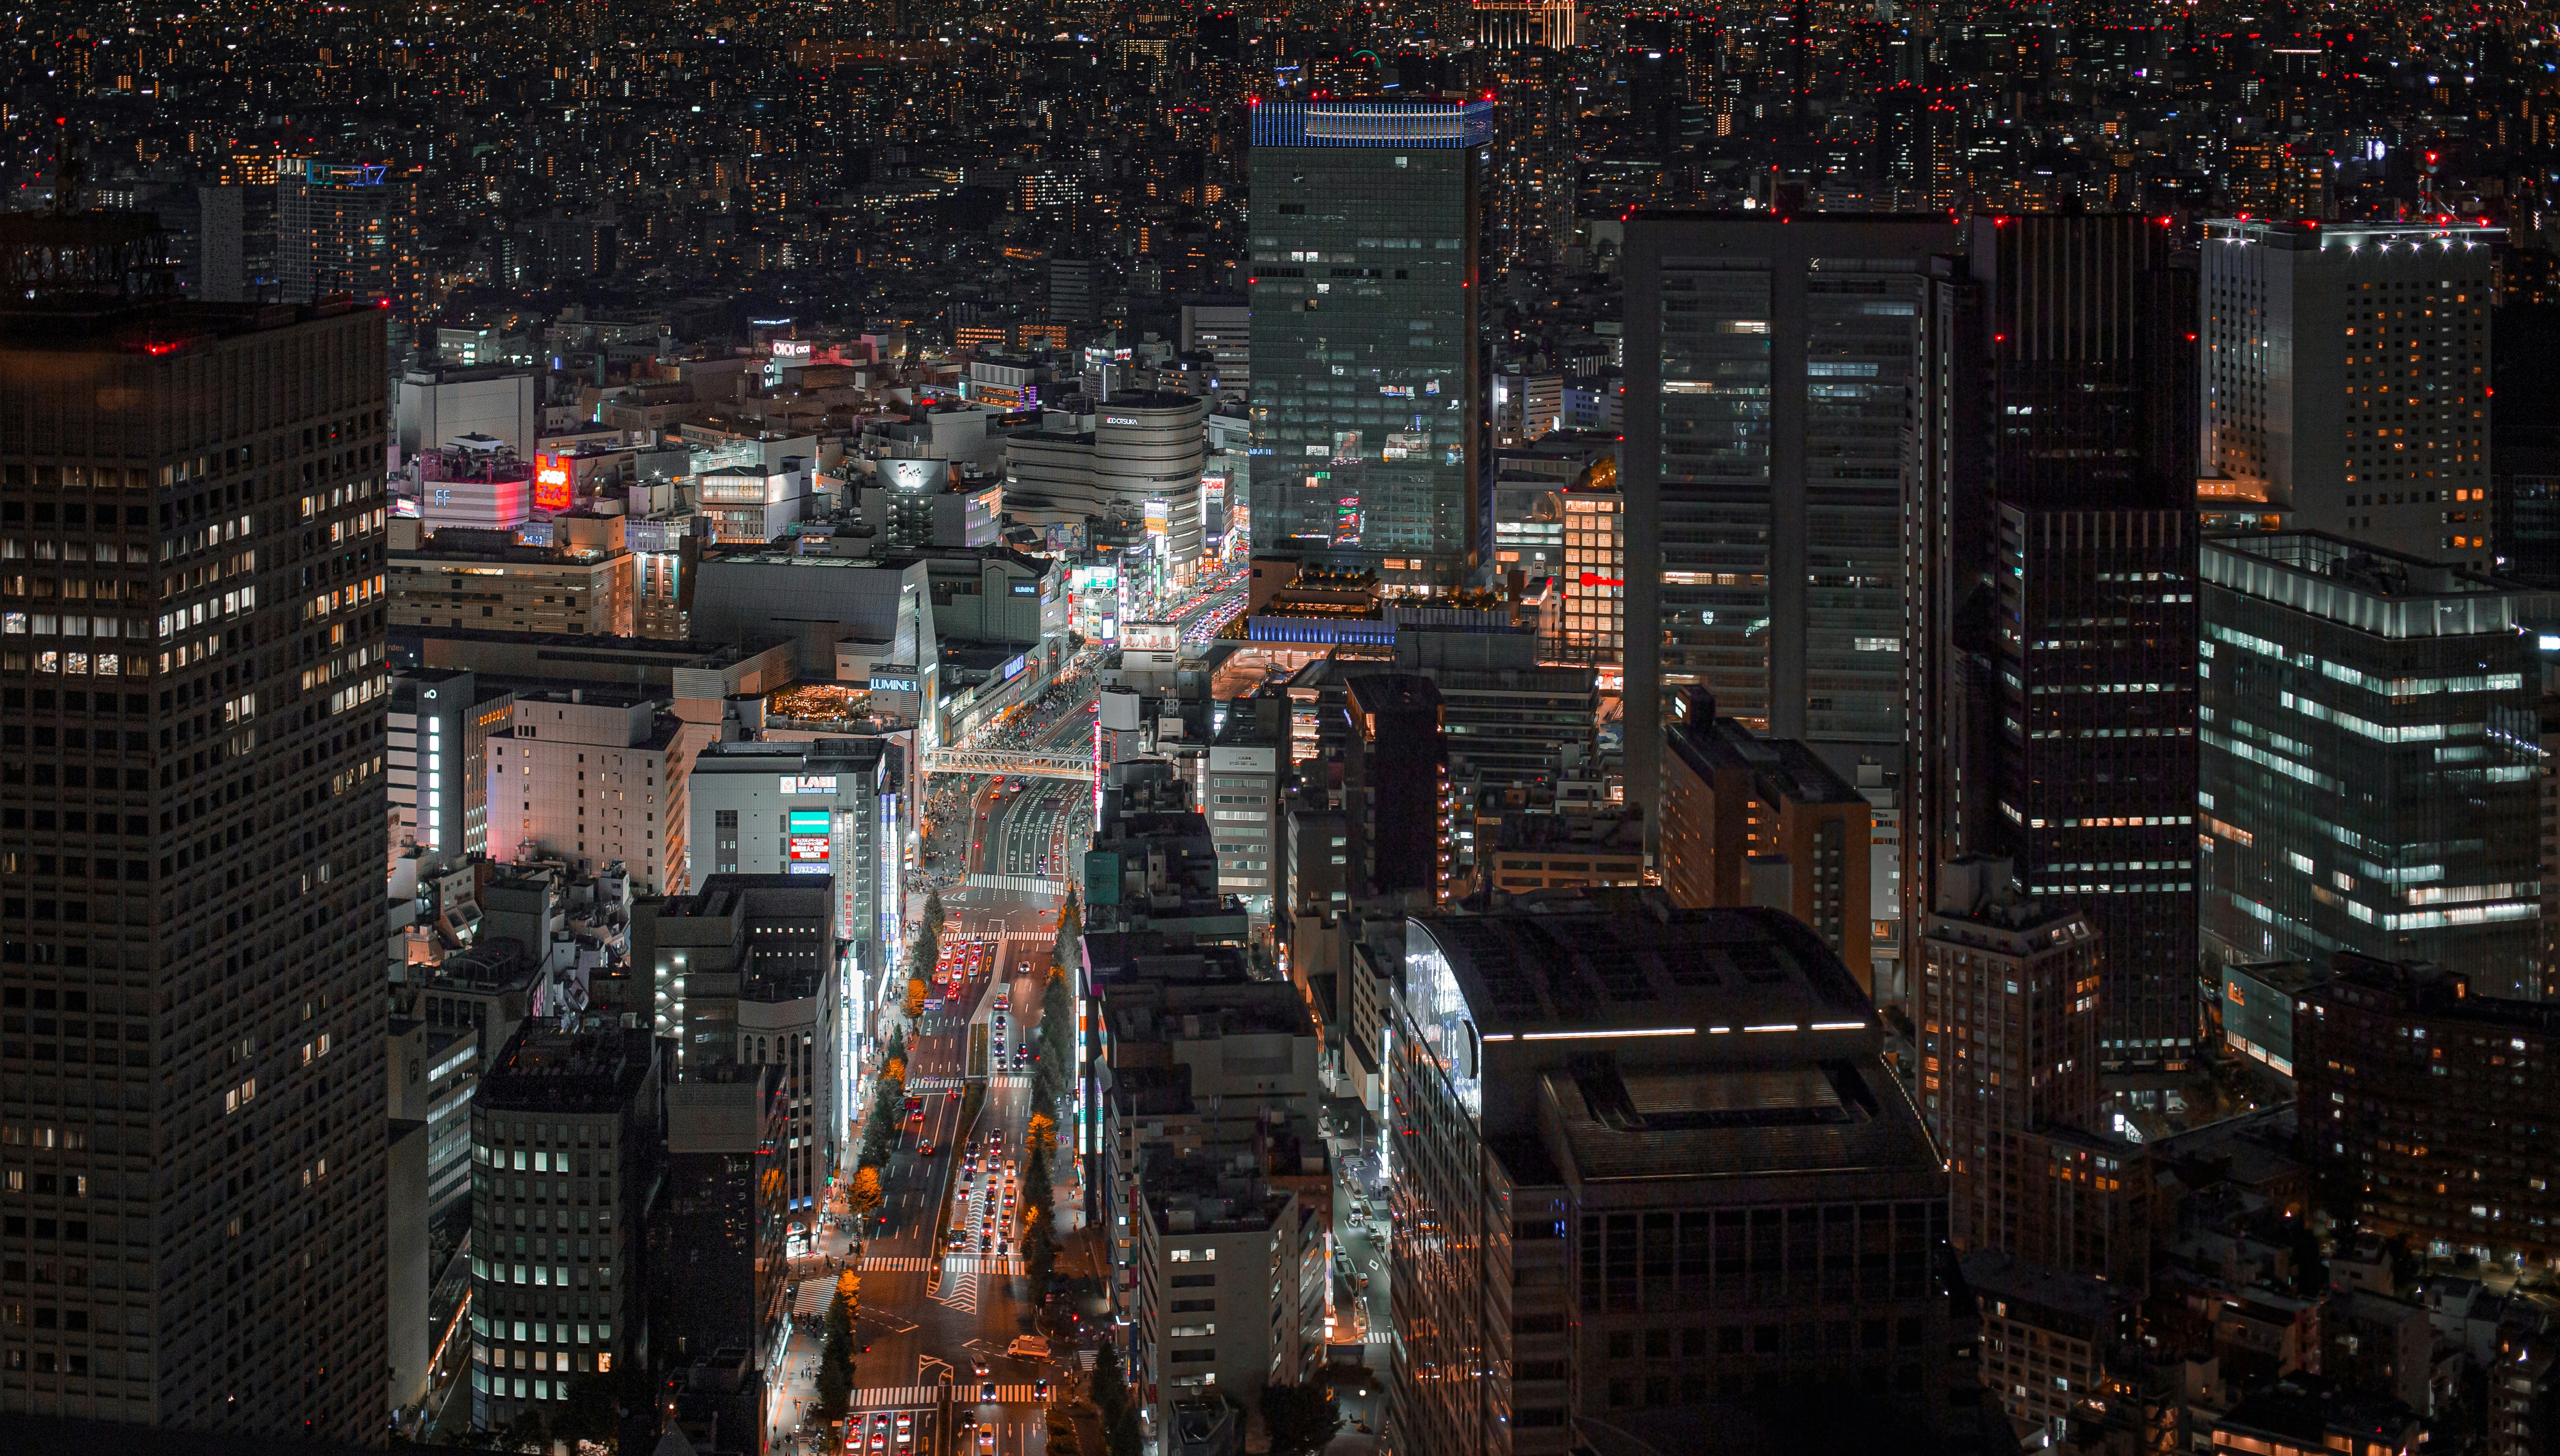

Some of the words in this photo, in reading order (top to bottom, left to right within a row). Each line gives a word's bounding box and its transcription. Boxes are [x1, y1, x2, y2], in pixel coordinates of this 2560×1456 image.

[435, 489, 451, 506] FF
[538, 485, 567, 500] スーパー
[871, 678, 909, 691] LUMINE
[911, 680, 917, 691] 1
[797, 776, 837, 788] LABI
